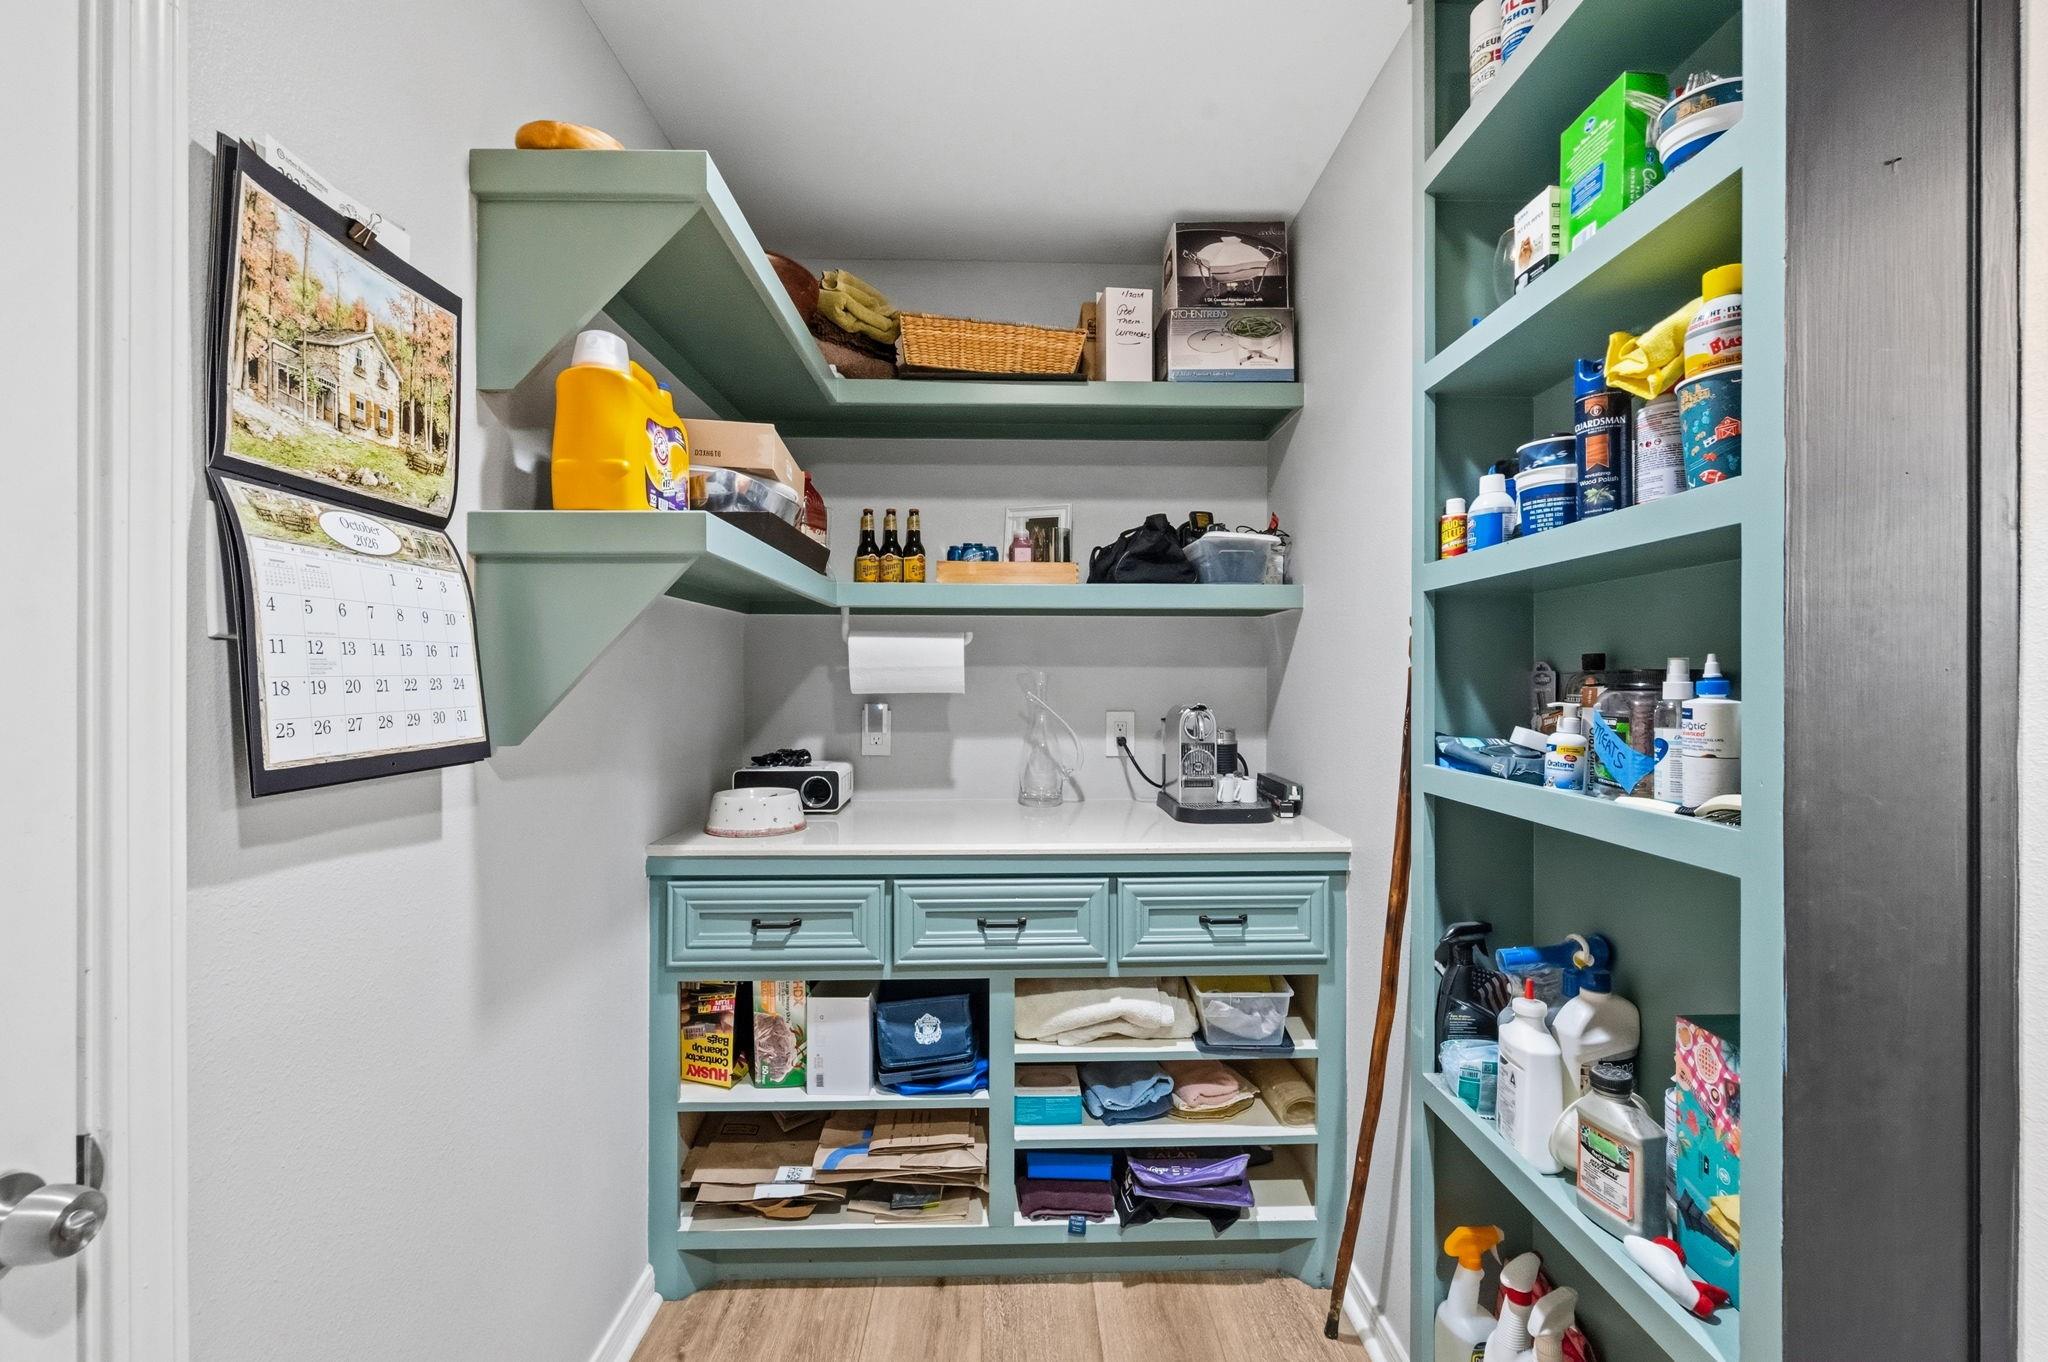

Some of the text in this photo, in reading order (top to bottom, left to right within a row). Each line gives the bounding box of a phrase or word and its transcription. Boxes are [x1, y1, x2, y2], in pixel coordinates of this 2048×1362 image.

[1574, 416, 1627, 433] GUARDSMAN
[1580, 476, 1619, 487] Wood Polish
[339, 516, 380, 536] October
[353, 533, 379, 550] 2026
[390, 574, 447, 593] 1 2 3
[266, 597, 455, 625] 4 5 6 7 8 9 10
[270, 639, 459, 658] 11 12 13 14 15 16 17
[273, 678, 465, 696] 18 19 20 21 22 23 24
[276, 710, 467, 738] 25 26 27 28 29 30 31
[1595, 720, 1626, 769] TREATS
[692, 1043, 729, 1057] Clean-Up
[706, 1035, 729, 1047] Bags
[685, 1053, 729, 1067] Contractor
[686, 1064, 729, 1082] HUSKY
